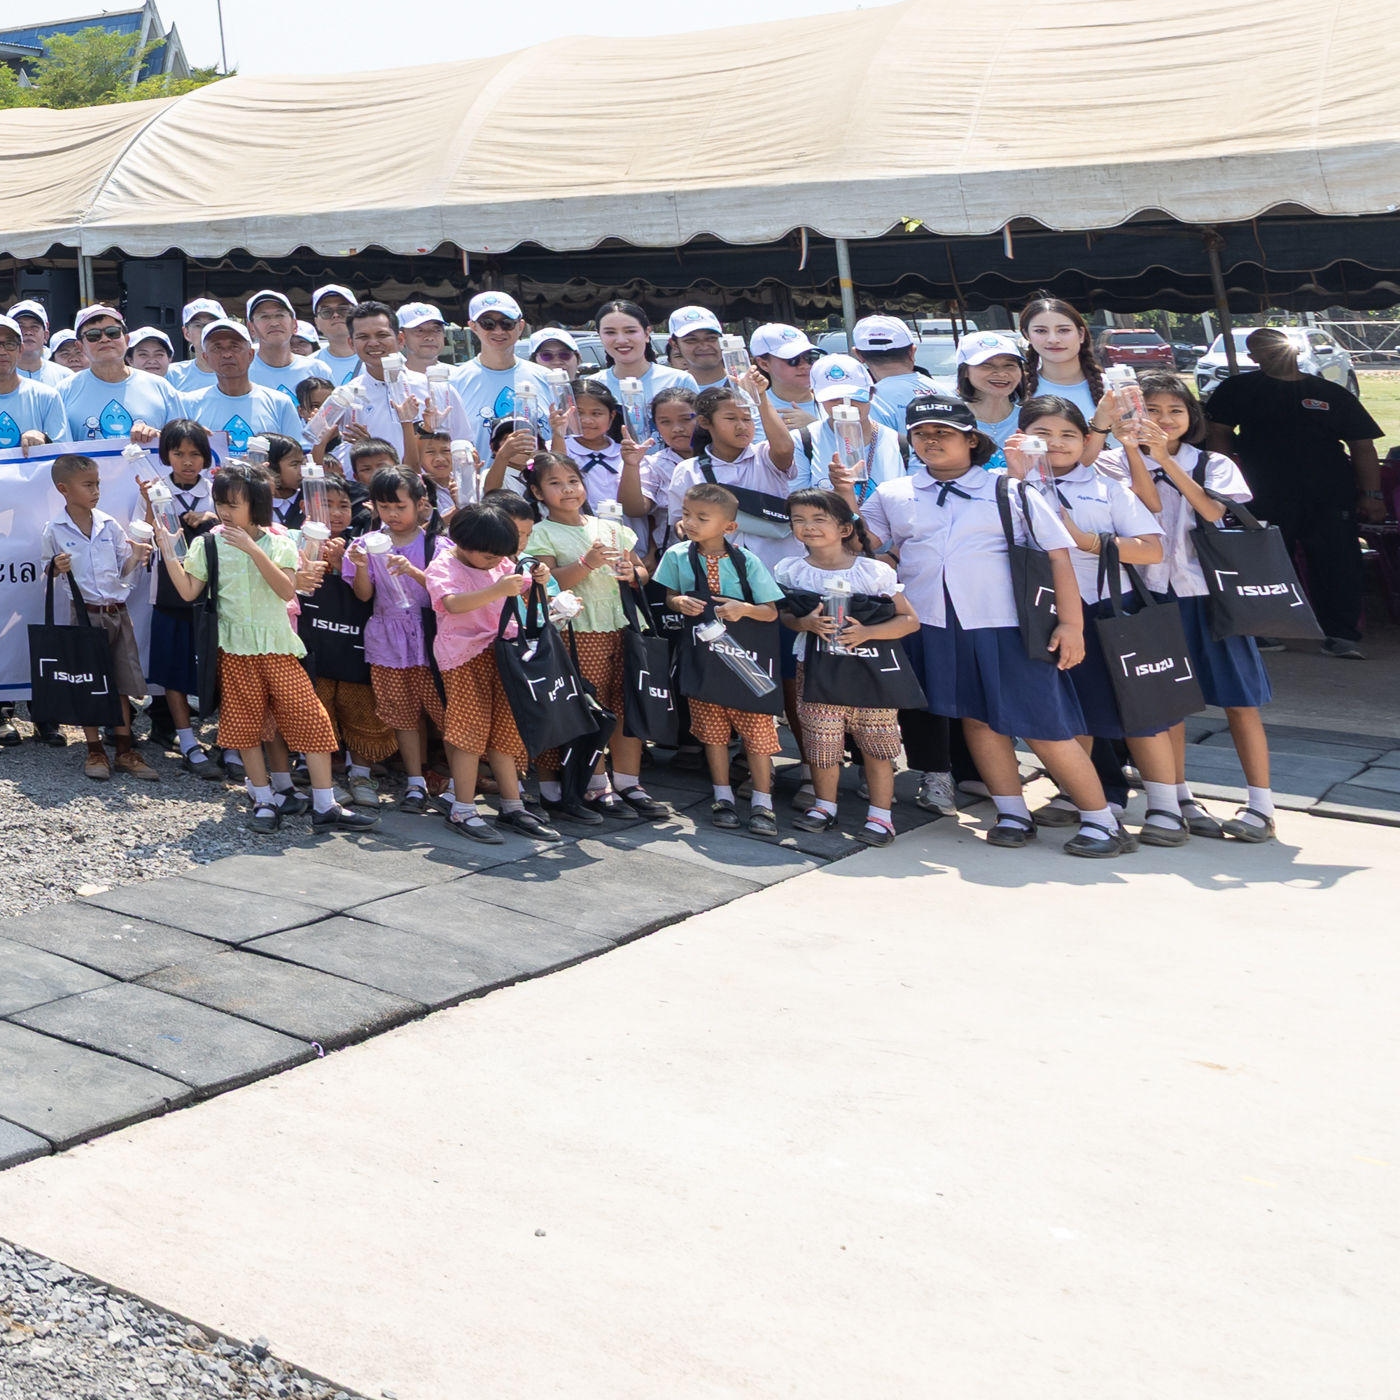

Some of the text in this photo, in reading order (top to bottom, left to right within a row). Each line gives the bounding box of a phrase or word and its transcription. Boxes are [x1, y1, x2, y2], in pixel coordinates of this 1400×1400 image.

[915, 403, 952, 412] ISUZU
[762, 509, 790, 520] ISUZU
[1236, 583, 1289, 596] ISUZU
[312, 618, 360, 635] ISUZU
[709, 642, 758, 661] ISUZU
[1135, 656, 1175, 676] ISUZU
[54, 671, 93, 683] ISUZU
[649, 686, 668, 699] ISU
